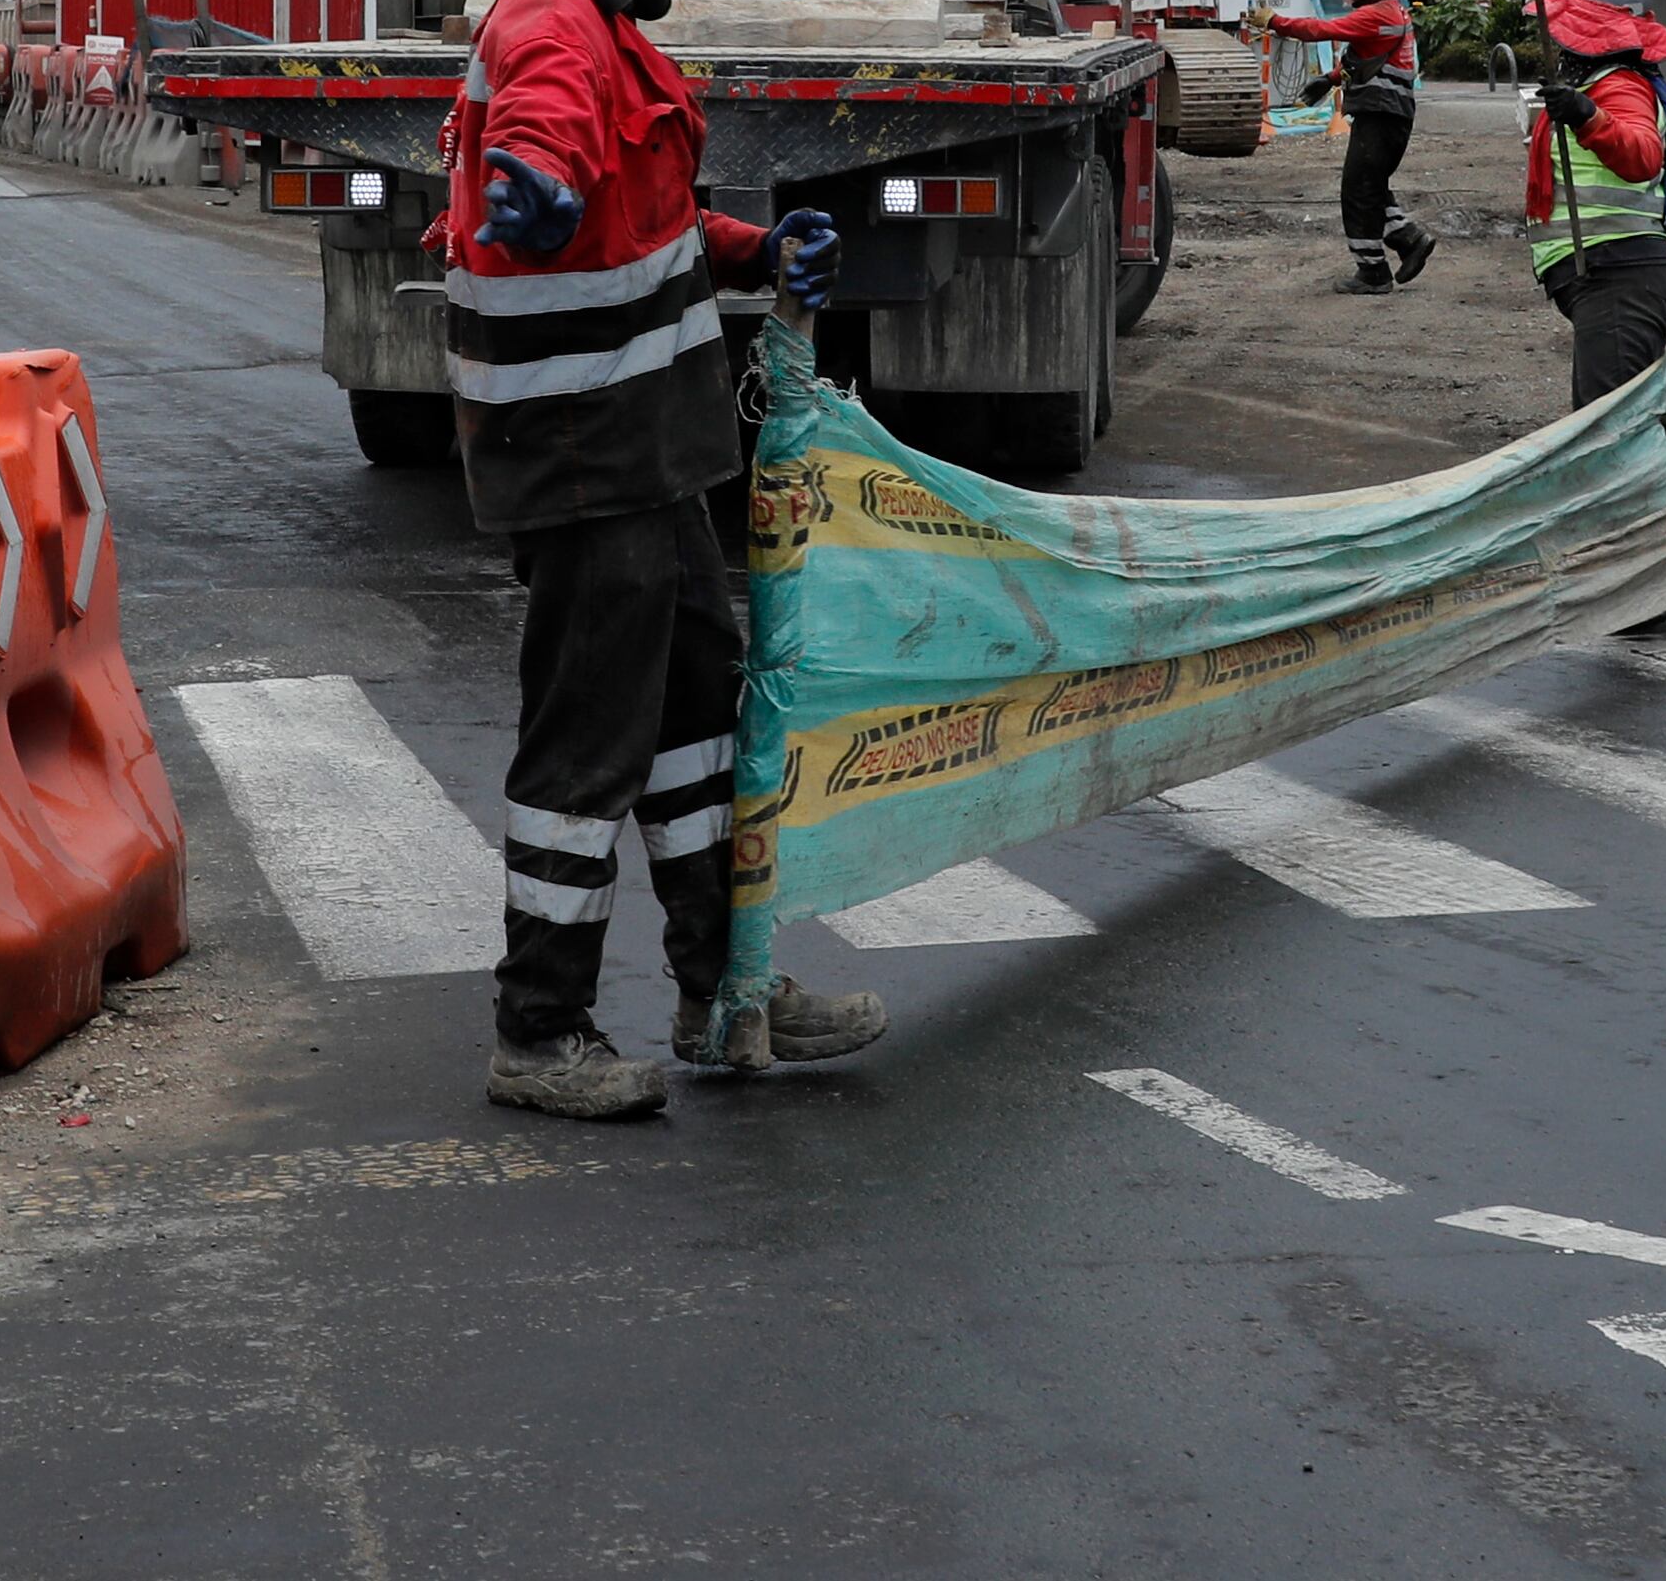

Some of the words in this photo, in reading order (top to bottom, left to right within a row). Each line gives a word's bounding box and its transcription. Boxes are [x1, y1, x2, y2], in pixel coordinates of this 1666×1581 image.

[856, 739, 923, 777] PELIGRO
[926, 729, 947, 759] NO
[947, 714, 980, 752] PASE
